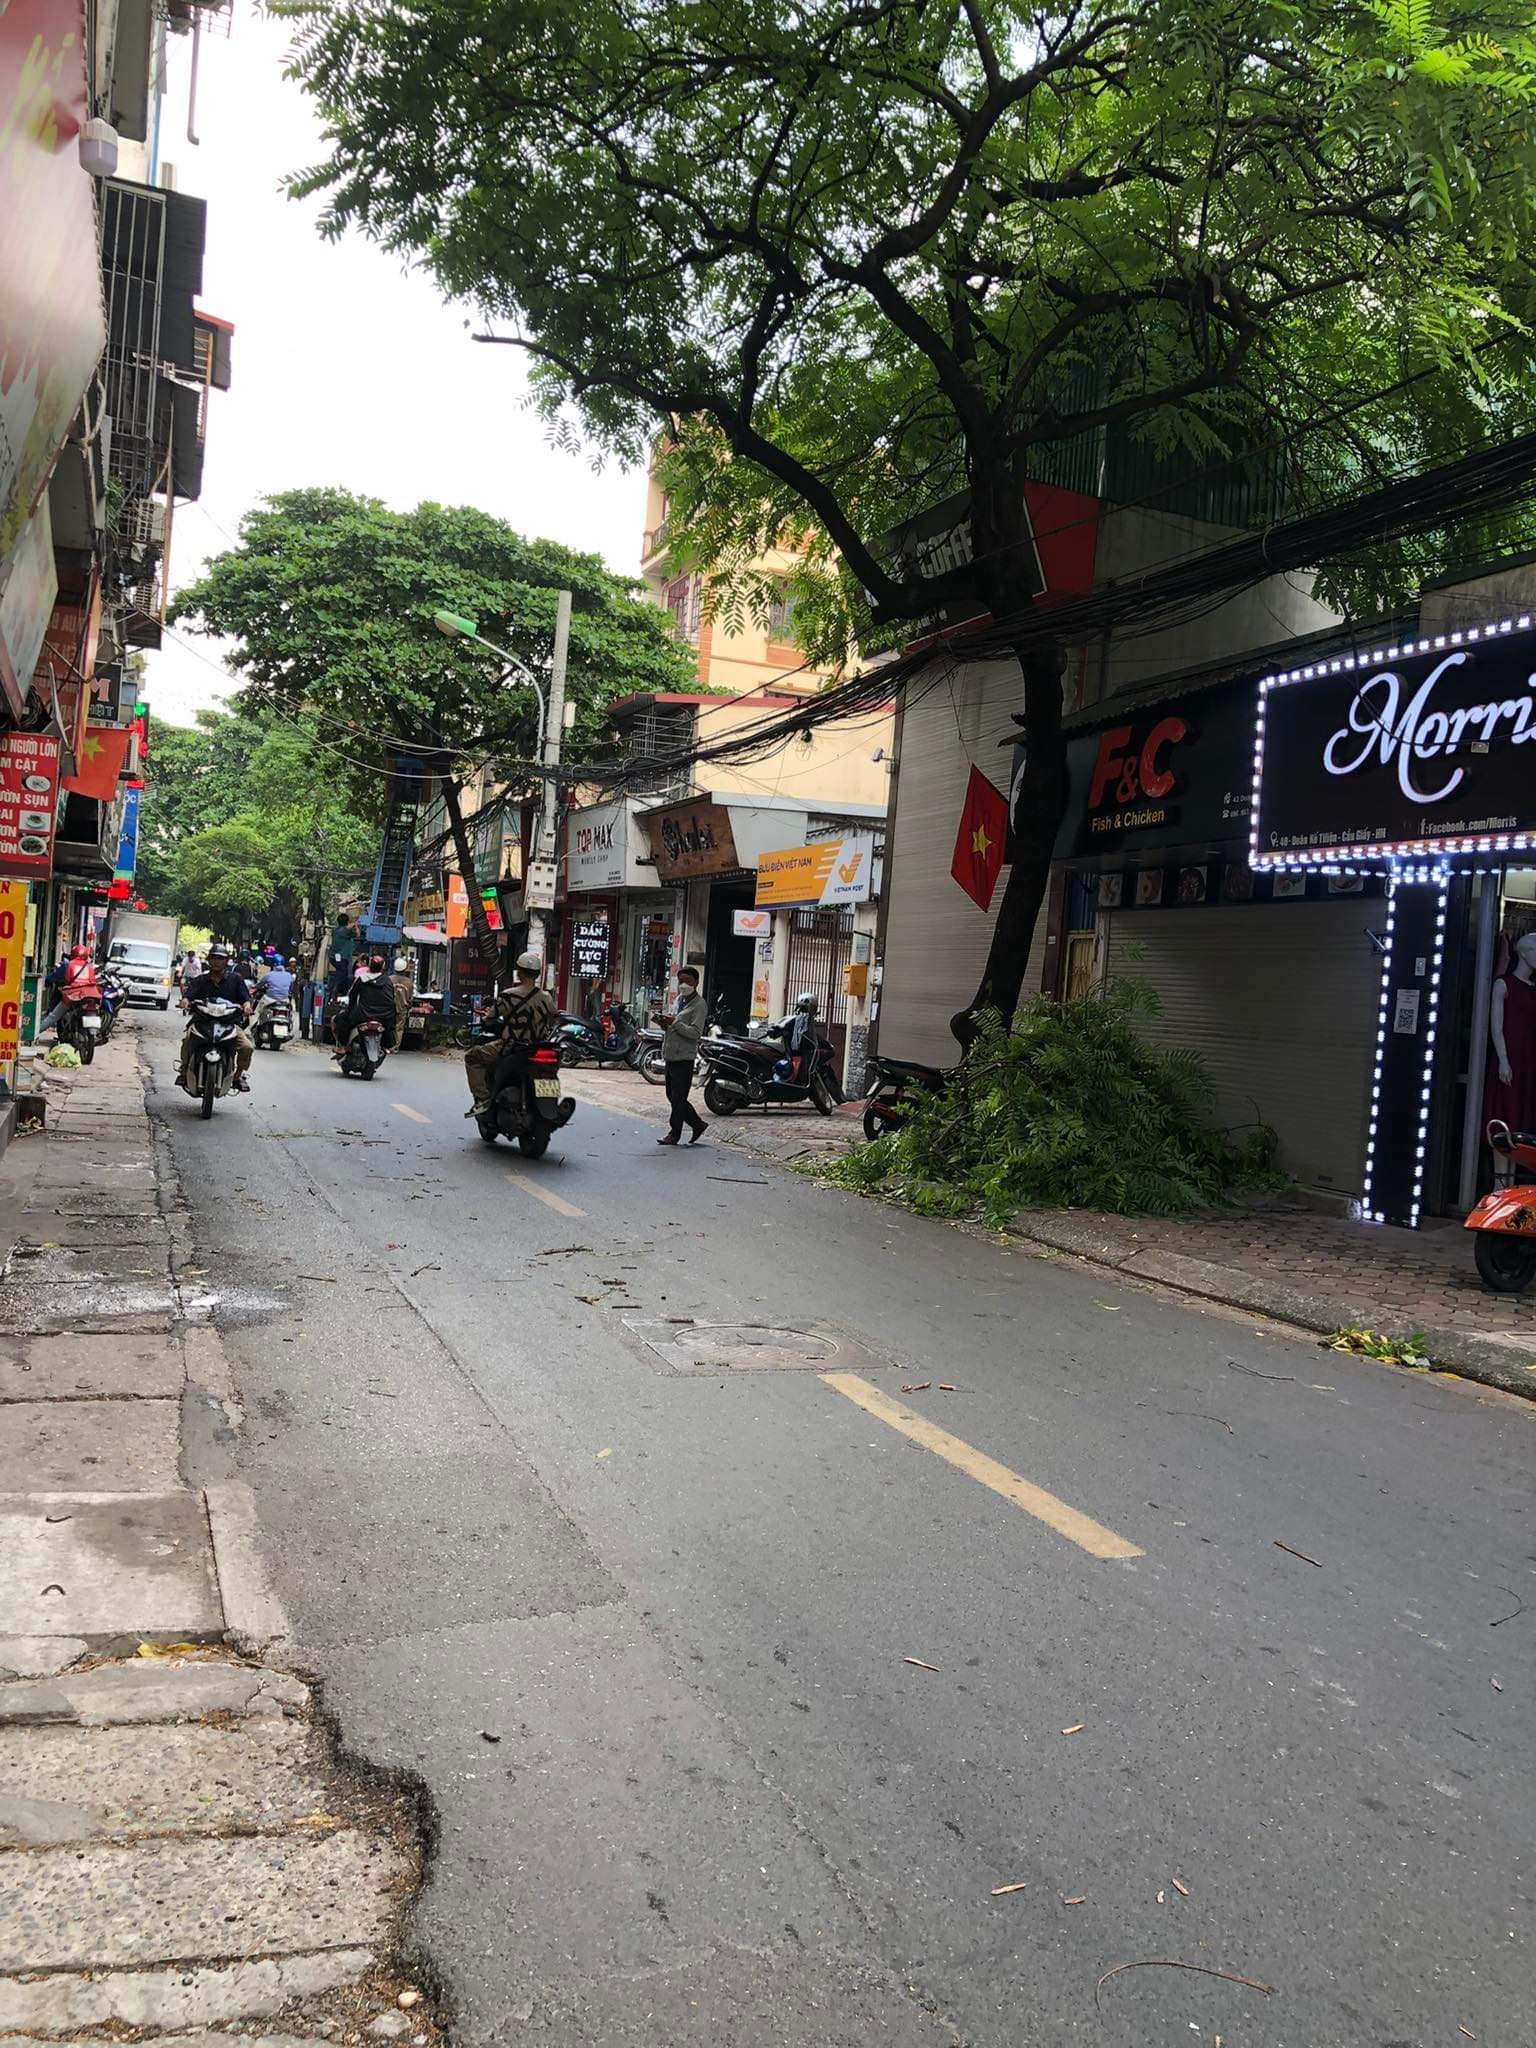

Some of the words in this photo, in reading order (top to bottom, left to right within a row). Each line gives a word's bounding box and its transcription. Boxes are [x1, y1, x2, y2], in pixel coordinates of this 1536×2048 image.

[1323, 652, 1536, 803] Morri
[15, 757, 38, 773] CẬT
[1088, 717, 1185, 809] F&C
[24, 793, 49, 808] SỤN
[1091, 815, 1112, 833] Fish
[1114, 813, 1121, 829] &
[1123, 808, 1165, 827] Chicken
